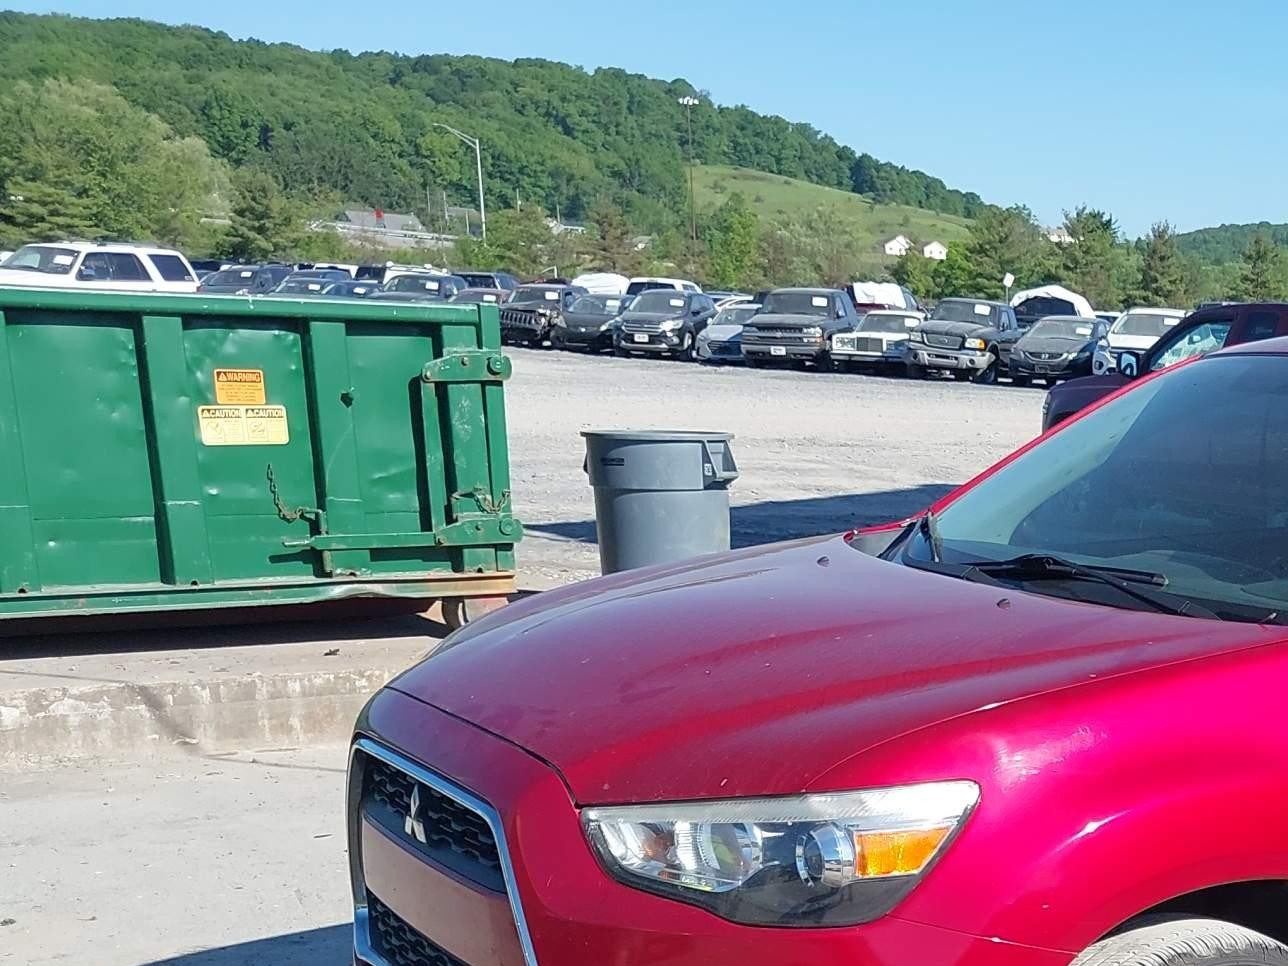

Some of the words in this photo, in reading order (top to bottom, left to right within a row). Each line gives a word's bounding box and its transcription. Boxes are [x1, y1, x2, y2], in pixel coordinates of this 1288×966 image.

[226, 372, 261, 382] WARNING
[209, 409, 241, 417] CAUTION
[254, 409, 284, 417] CAUTION
